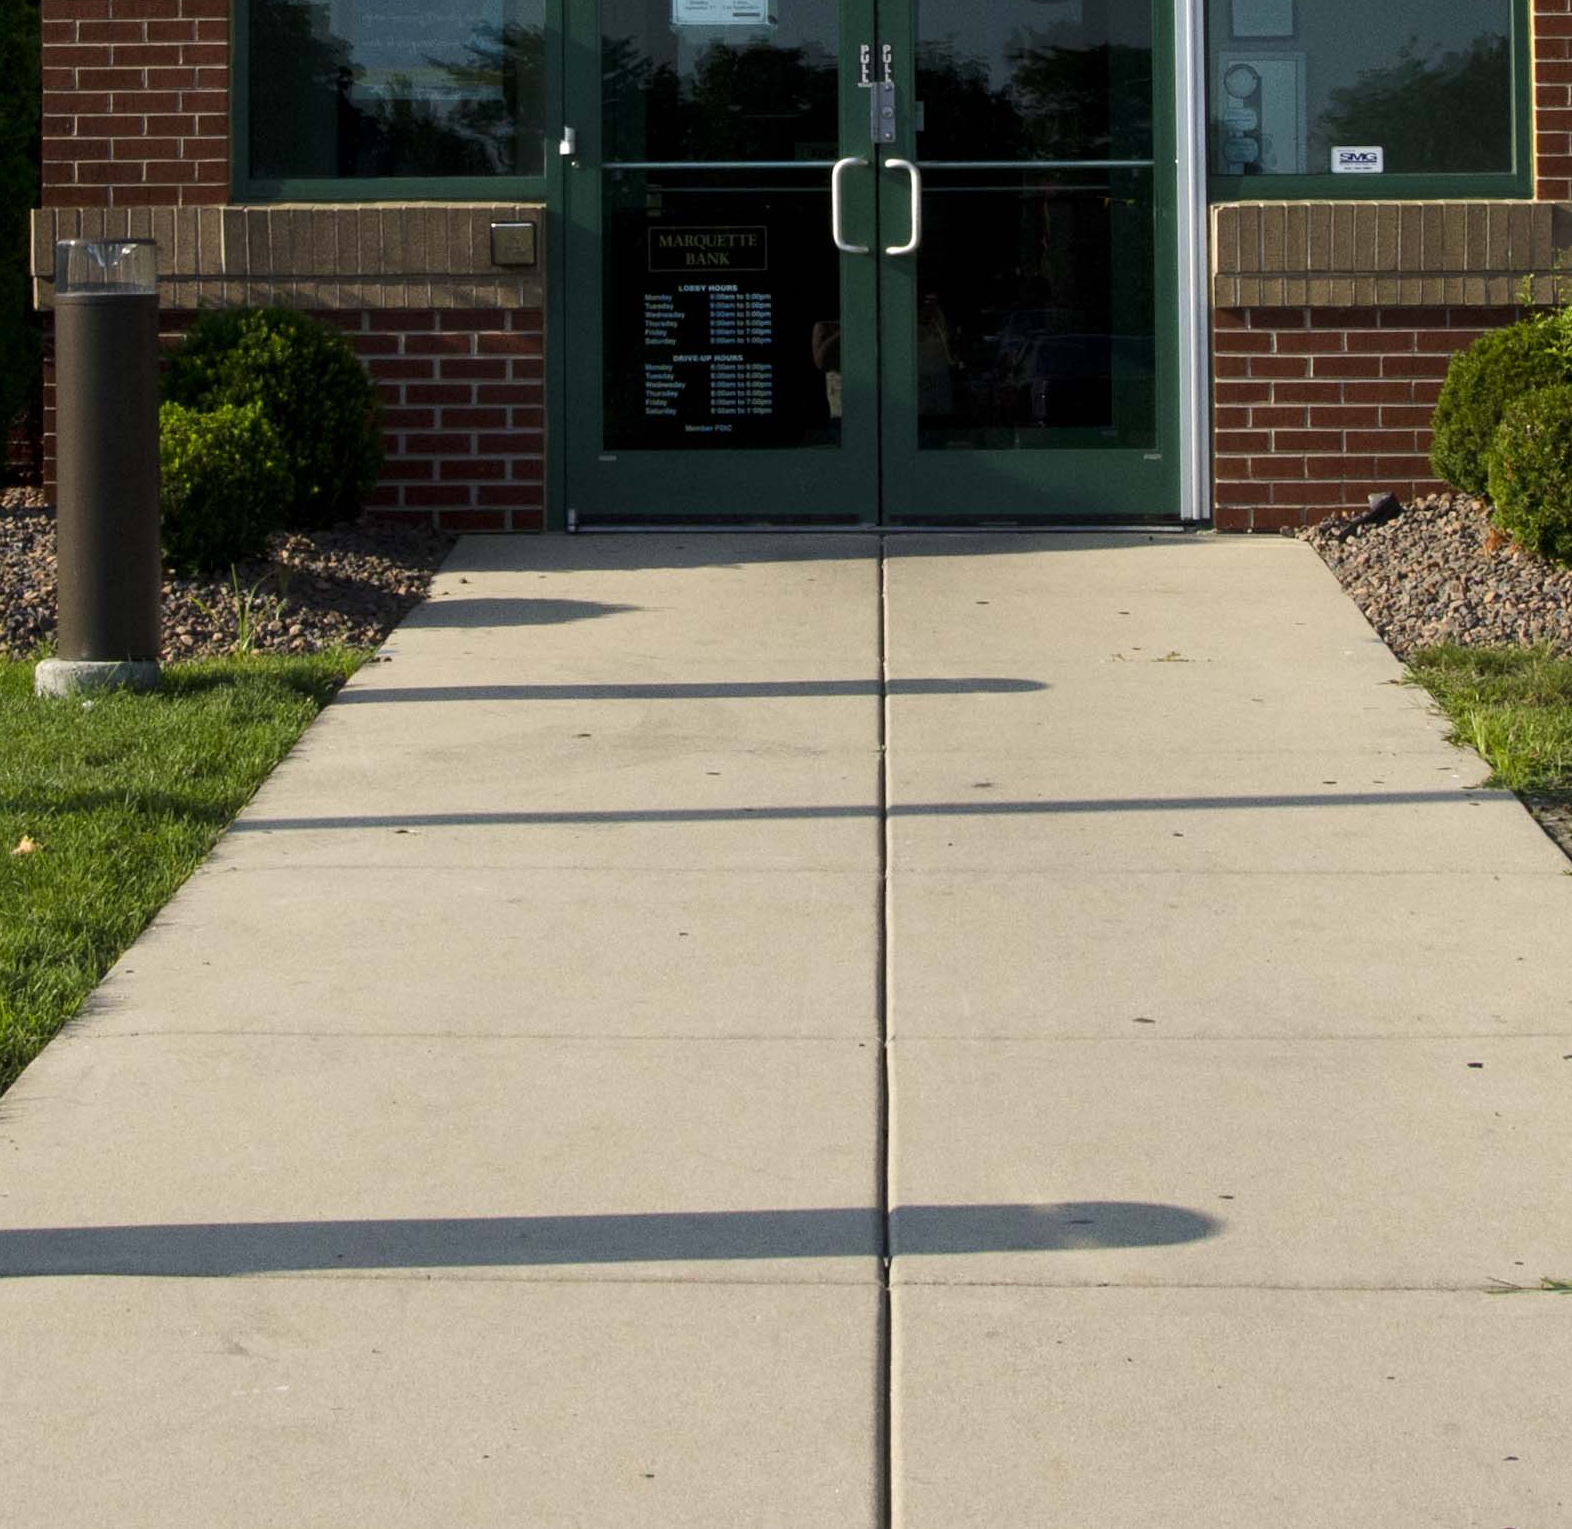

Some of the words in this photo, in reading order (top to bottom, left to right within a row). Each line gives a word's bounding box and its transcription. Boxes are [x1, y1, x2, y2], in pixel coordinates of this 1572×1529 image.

[860, 44, 870, 83] PULL
[882, 44, 892, 83] PULL
[1339, 152, 1378, 162] SMG
[658, 234, 758, 249] MARQUETTE
[685, 252, 731, 265] BANK
